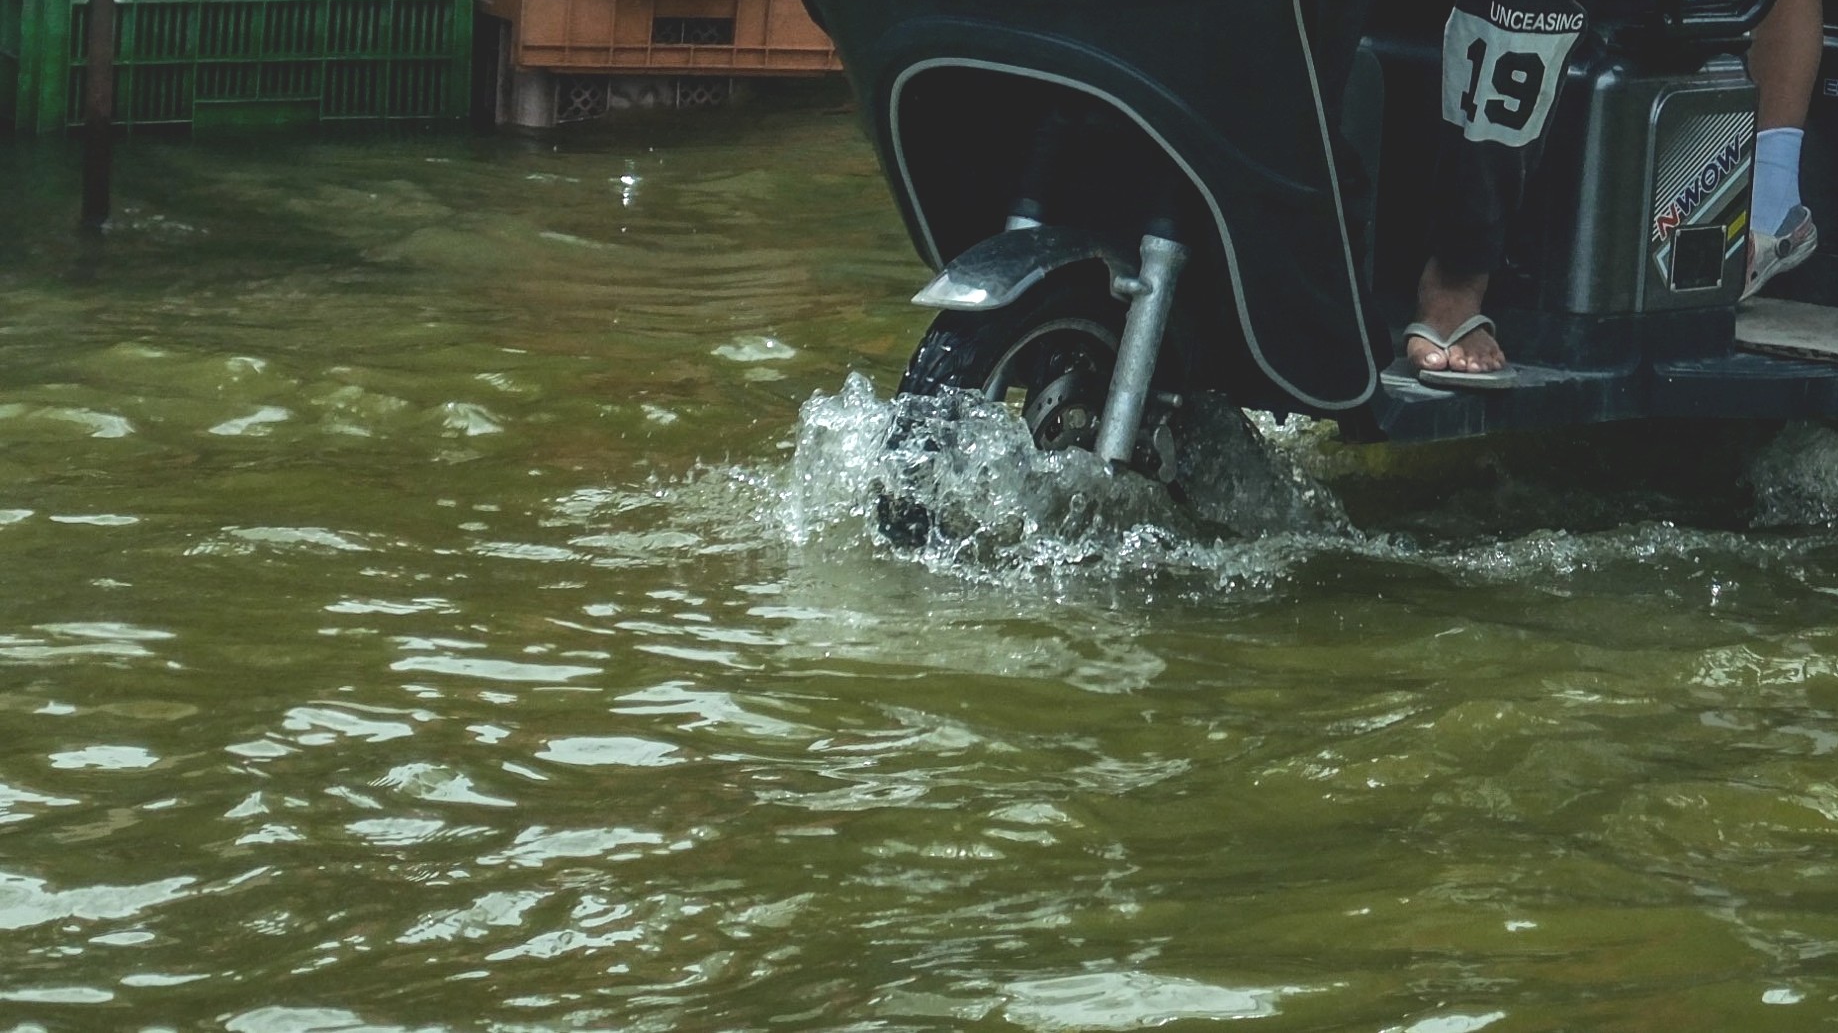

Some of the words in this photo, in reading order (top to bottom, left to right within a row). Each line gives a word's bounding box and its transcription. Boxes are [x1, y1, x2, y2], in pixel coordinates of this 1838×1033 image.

[1489, 0, 1584, 31] UNCEASING
[1460, 36, 1546, 131] 19
[1656, 132, 1743, 242] NWOW
